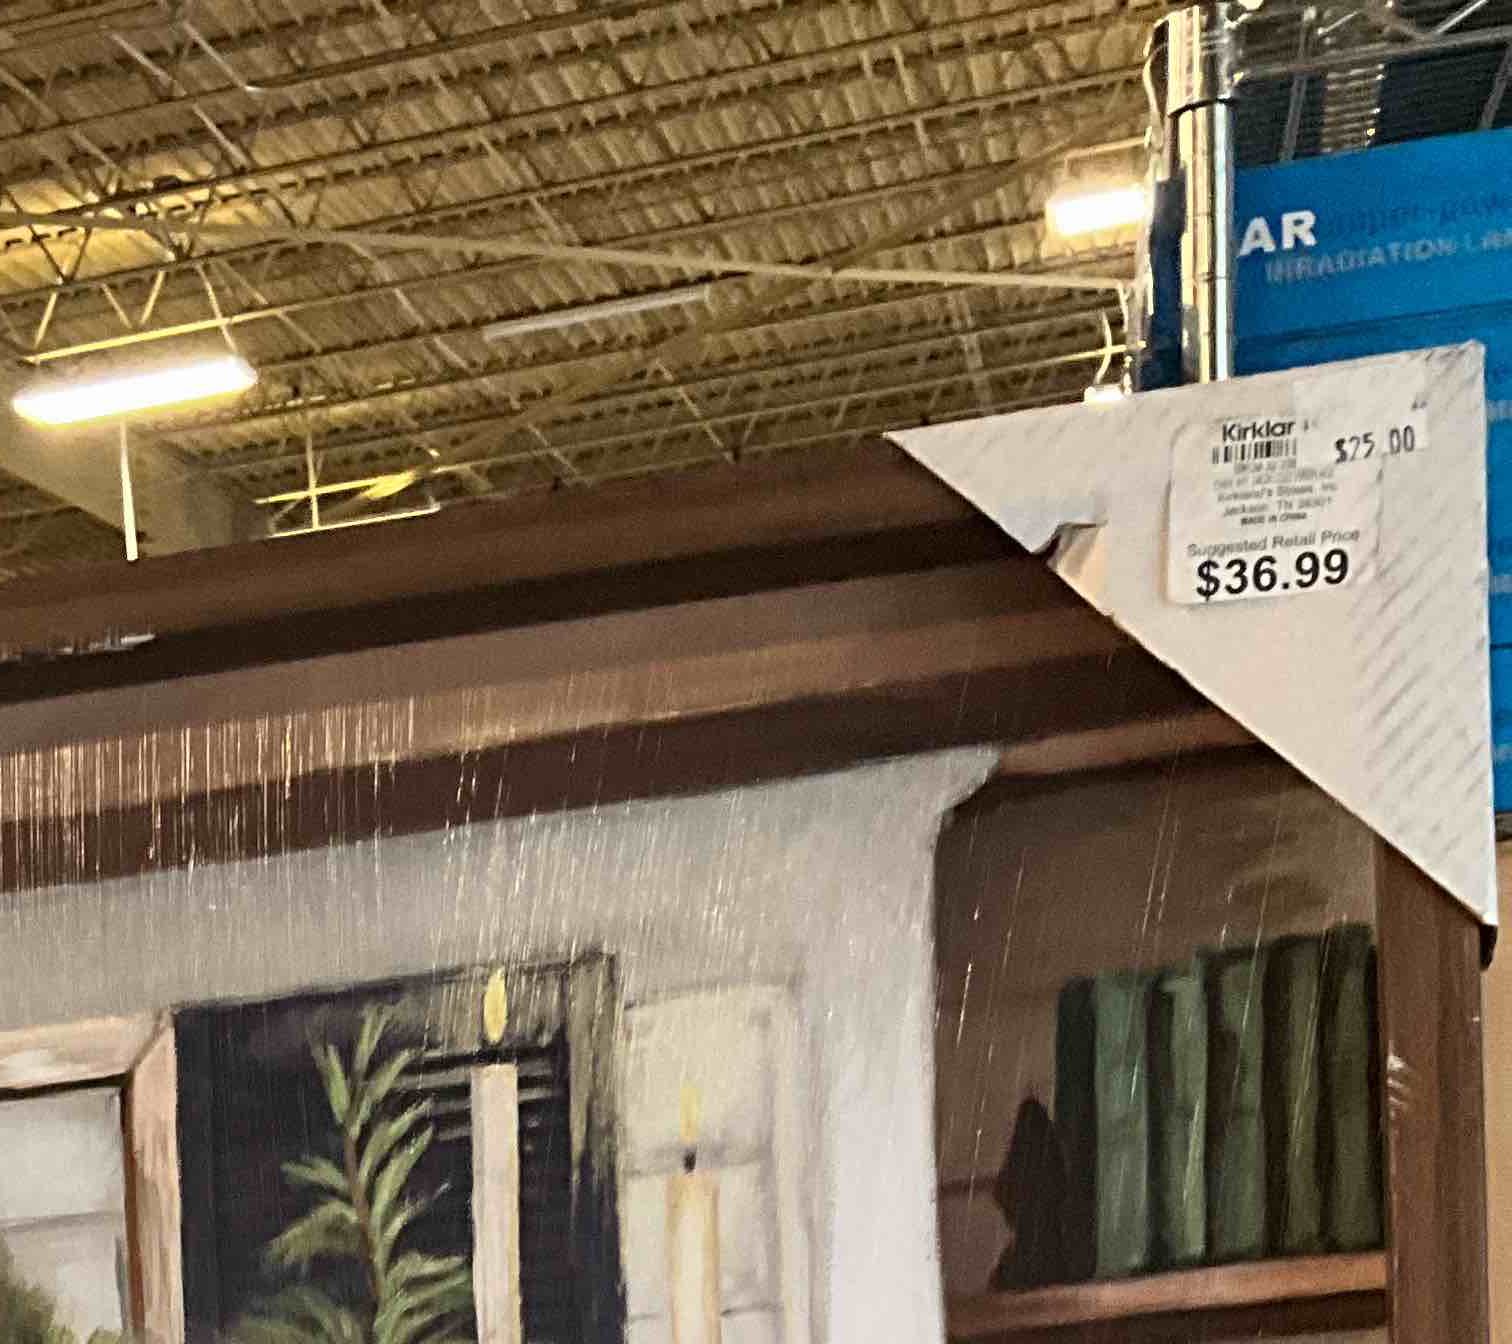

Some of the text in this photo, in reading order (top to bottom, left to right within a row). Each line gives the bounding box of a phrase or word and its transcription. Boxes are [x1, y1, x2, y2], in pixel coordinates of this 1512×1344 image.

[1188, 528, 1361, 558] Suggested Retail Price
[1196, 547, 1349, 602] $36.99
